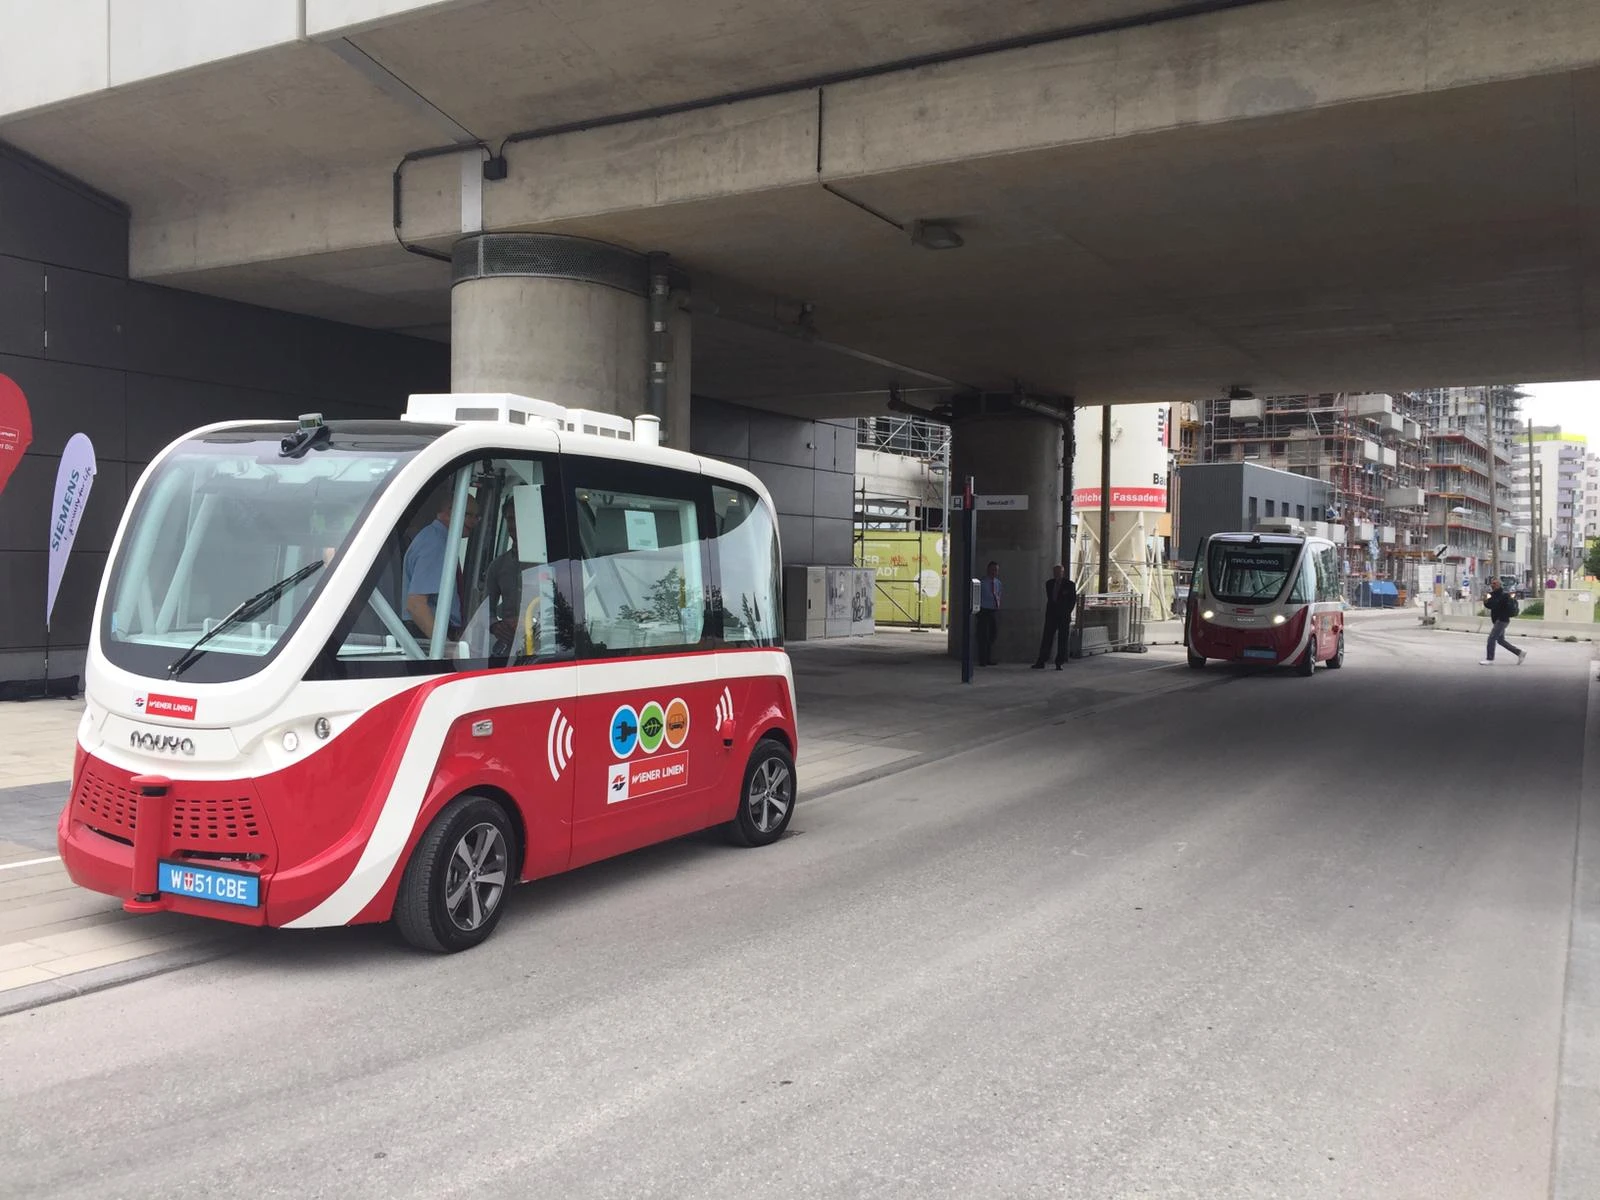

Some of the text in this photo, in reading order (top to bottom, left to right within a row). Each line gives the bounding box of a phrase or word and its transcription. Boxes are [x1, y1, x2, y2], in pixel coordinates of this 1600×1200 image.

[52, 469, 80, 552] SIEMENS
[148, 700, 193, 713] WIENER LINIEN
[632, 764, 684, 784] WIENER LINIEN
[170, 869, 183, 889] W
